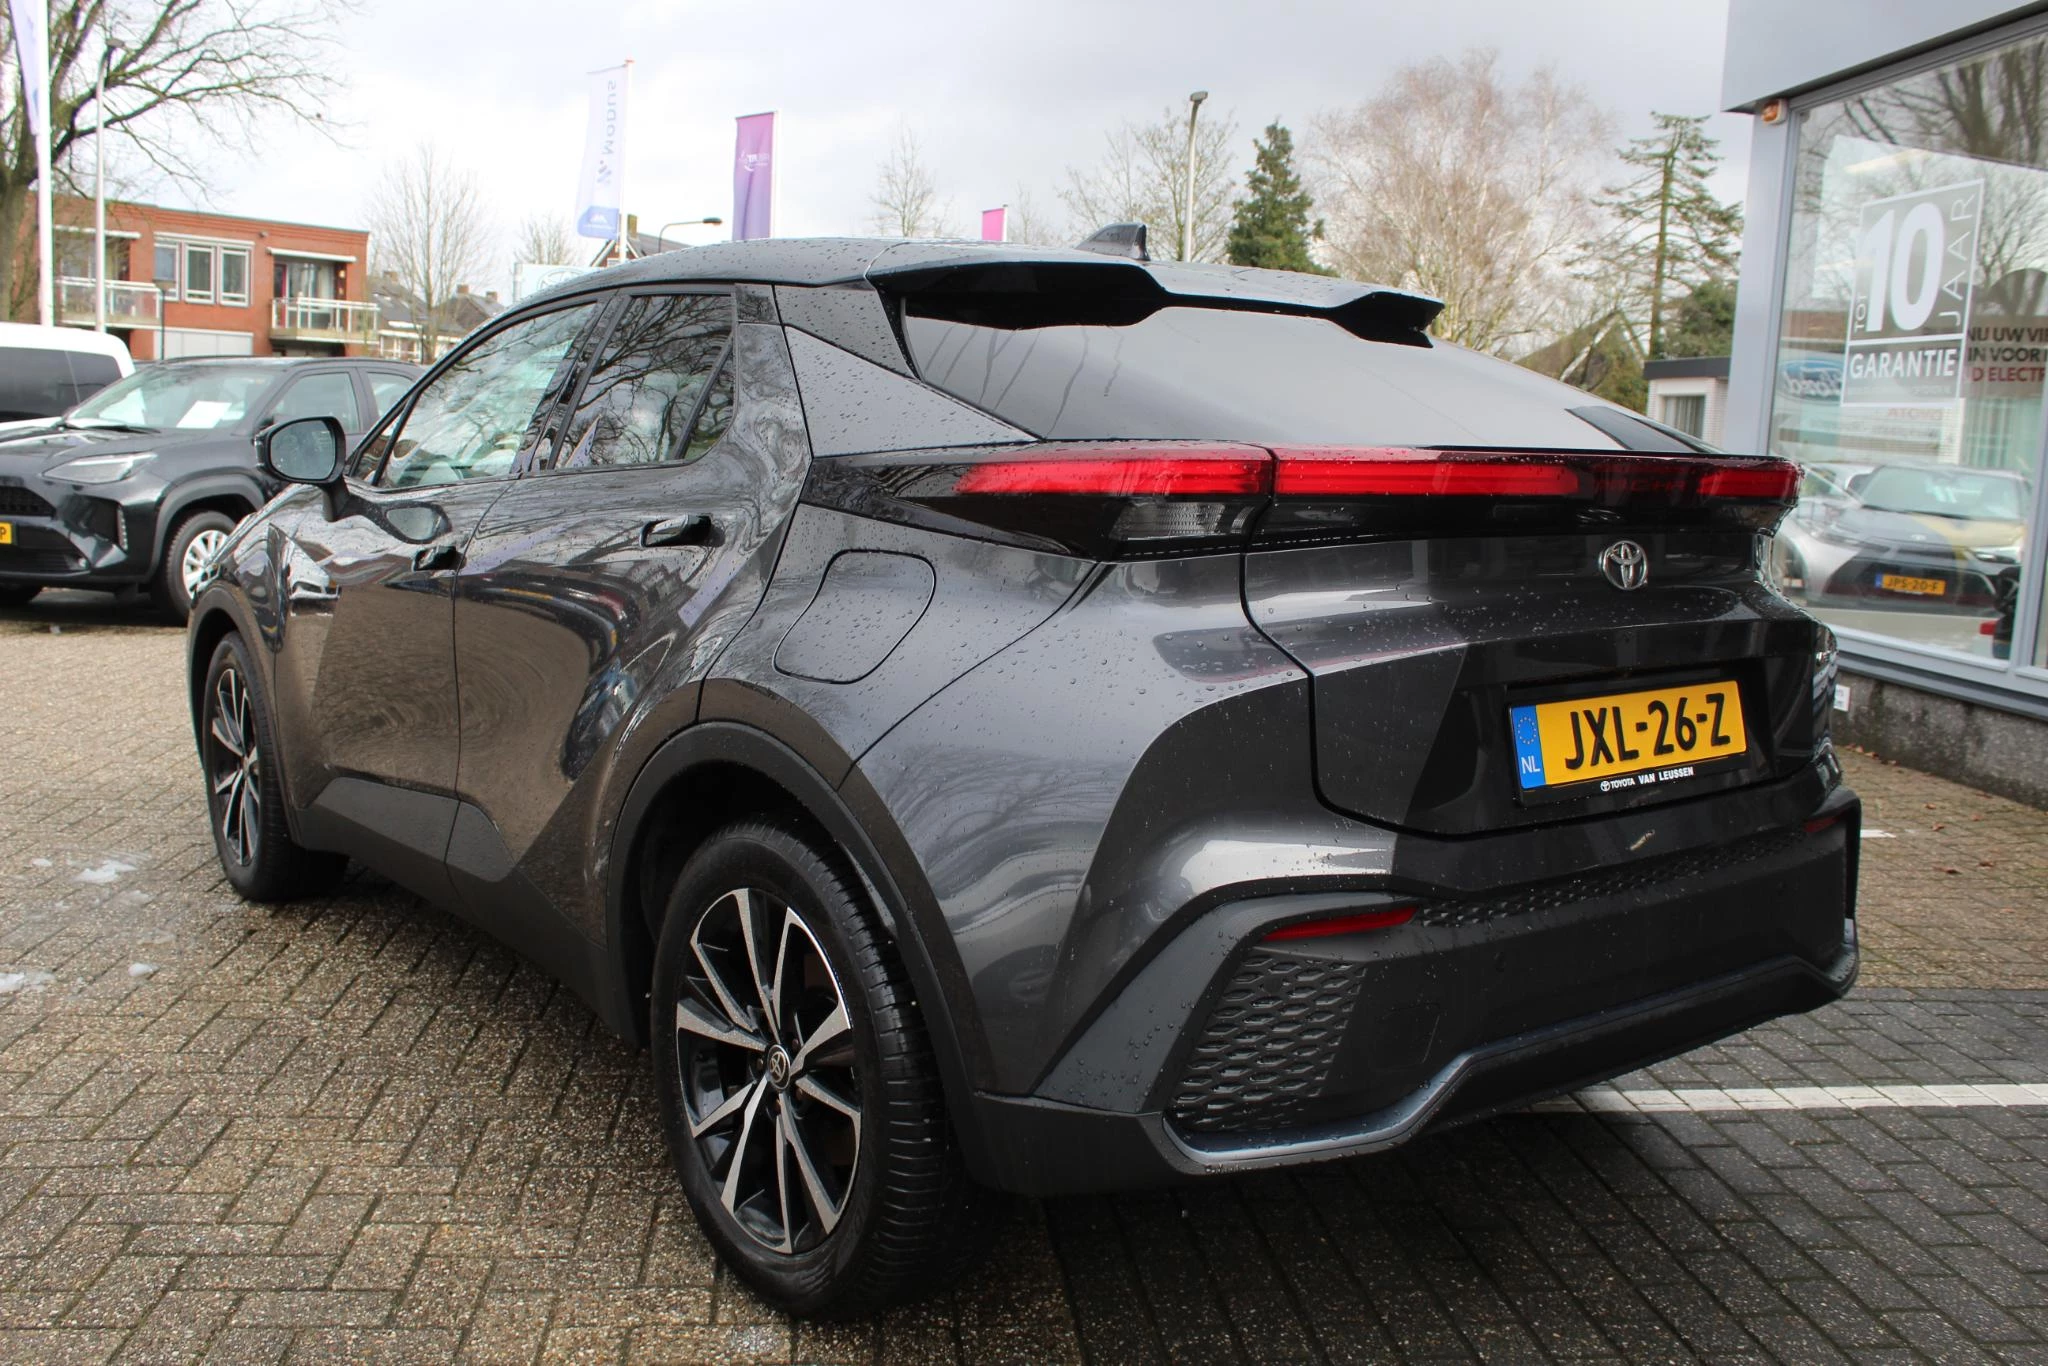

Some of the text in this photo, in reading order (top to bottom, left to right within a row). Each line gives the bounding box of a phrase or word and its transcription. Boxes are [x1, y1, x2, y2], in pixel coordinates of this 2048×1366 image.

[1859, 202, 1945, 333] 10
[1939, 193, 1976, 327] JAAR
[1993, 327, 2025, 342] UW
[1849, 348, 1958, 379] GARANTIE
[1990, 347, 2041, 361] VOOR
[1565, 692, 1731, 770] JXL-26-Z
[1521, 755, 1541, 775] NL
[1610, 766, 1694, 789] TOYOTA VAN LEUSSEN
